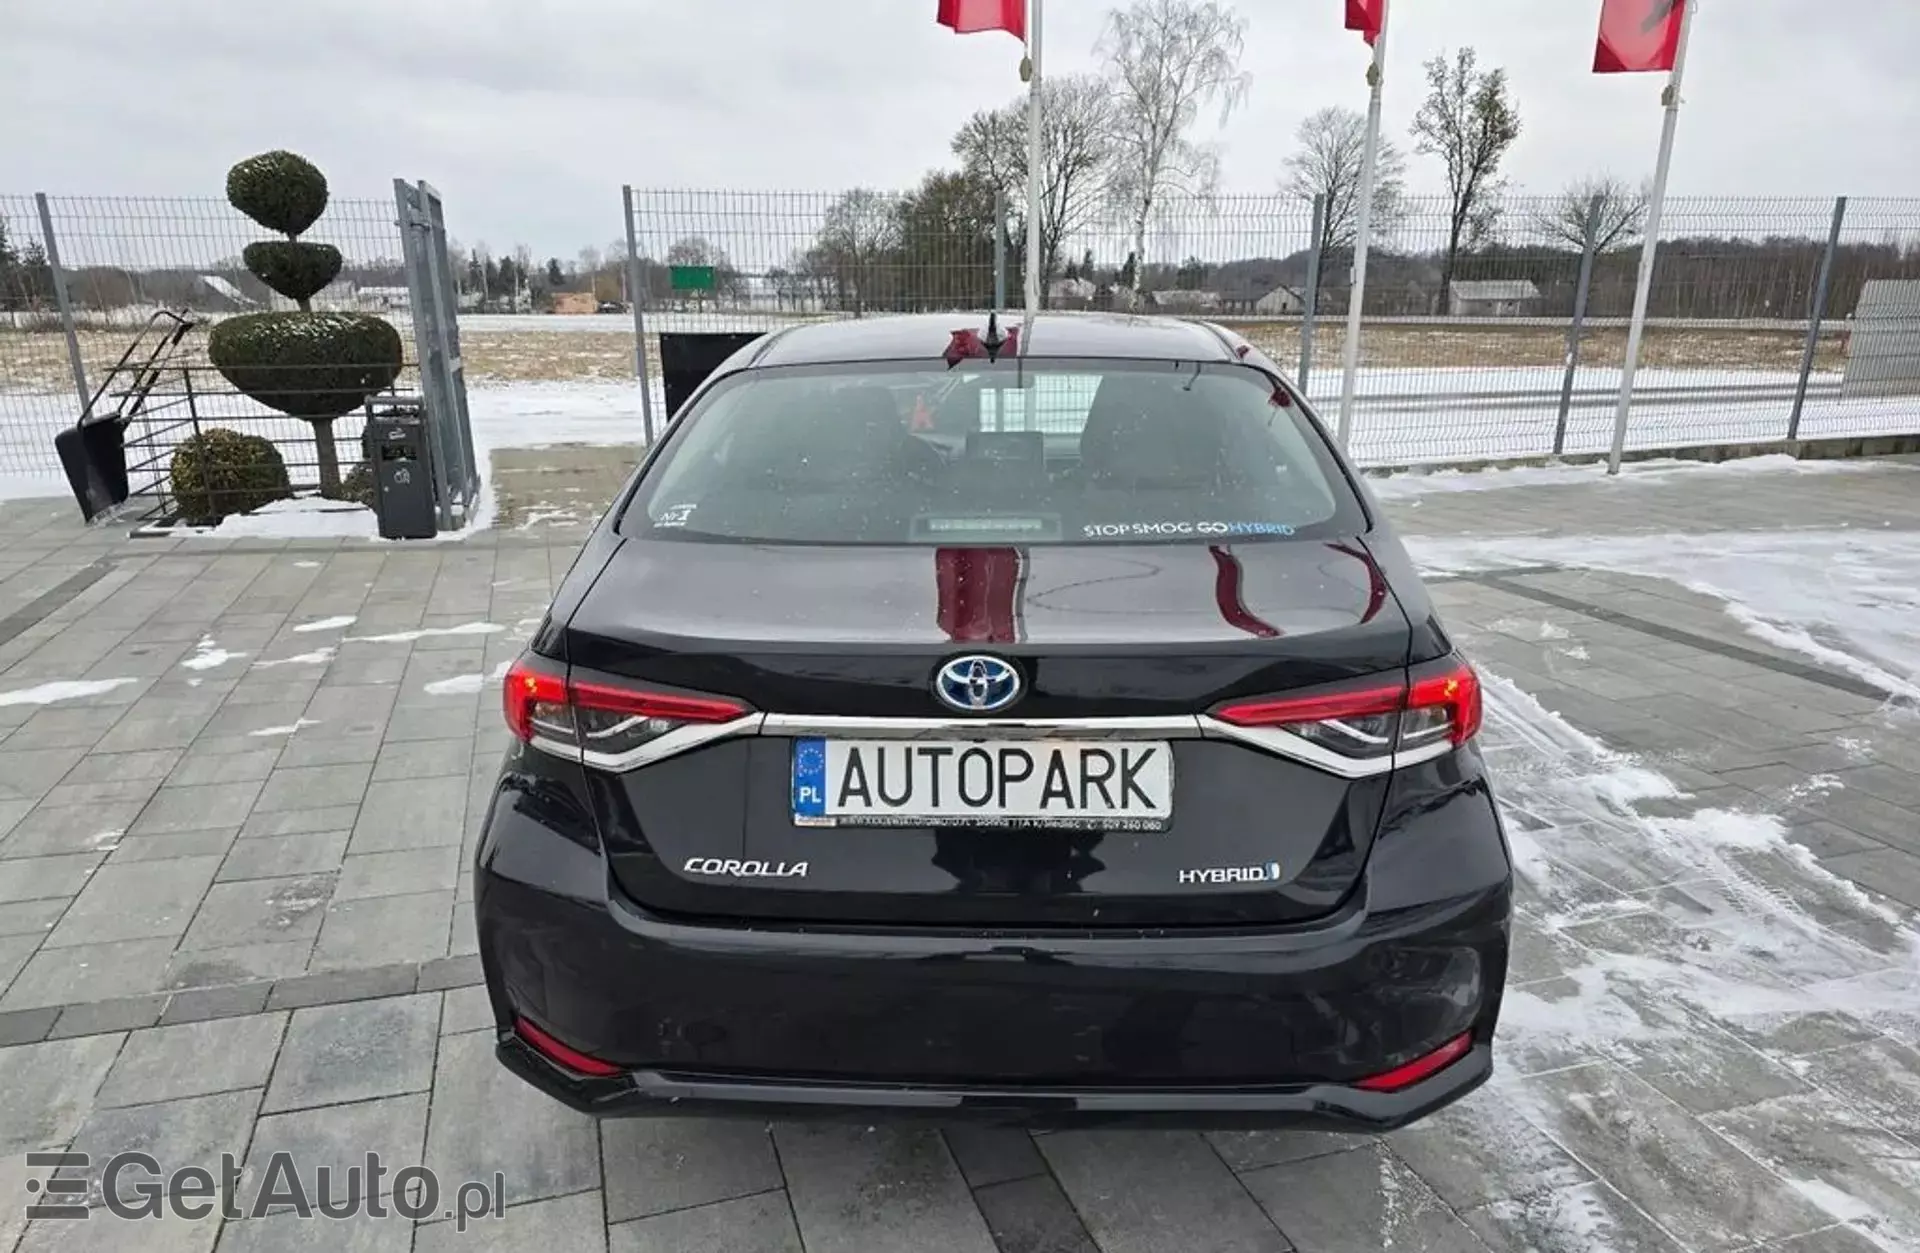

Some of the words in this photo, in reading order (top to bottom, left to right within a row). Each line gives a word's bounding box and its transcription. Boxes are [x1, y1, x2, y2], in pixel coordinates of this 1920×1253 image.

[1083, 524, 1130, 537] STOP
[1132, 522, 1193, 535] SMOG
[837, 746, 1157, 809] AUTOPARK
[799, 788, 822, 804] PL
[684, 858, 809, 878] COROLLA
[1179, 867, 1264, 883] HYBRID
